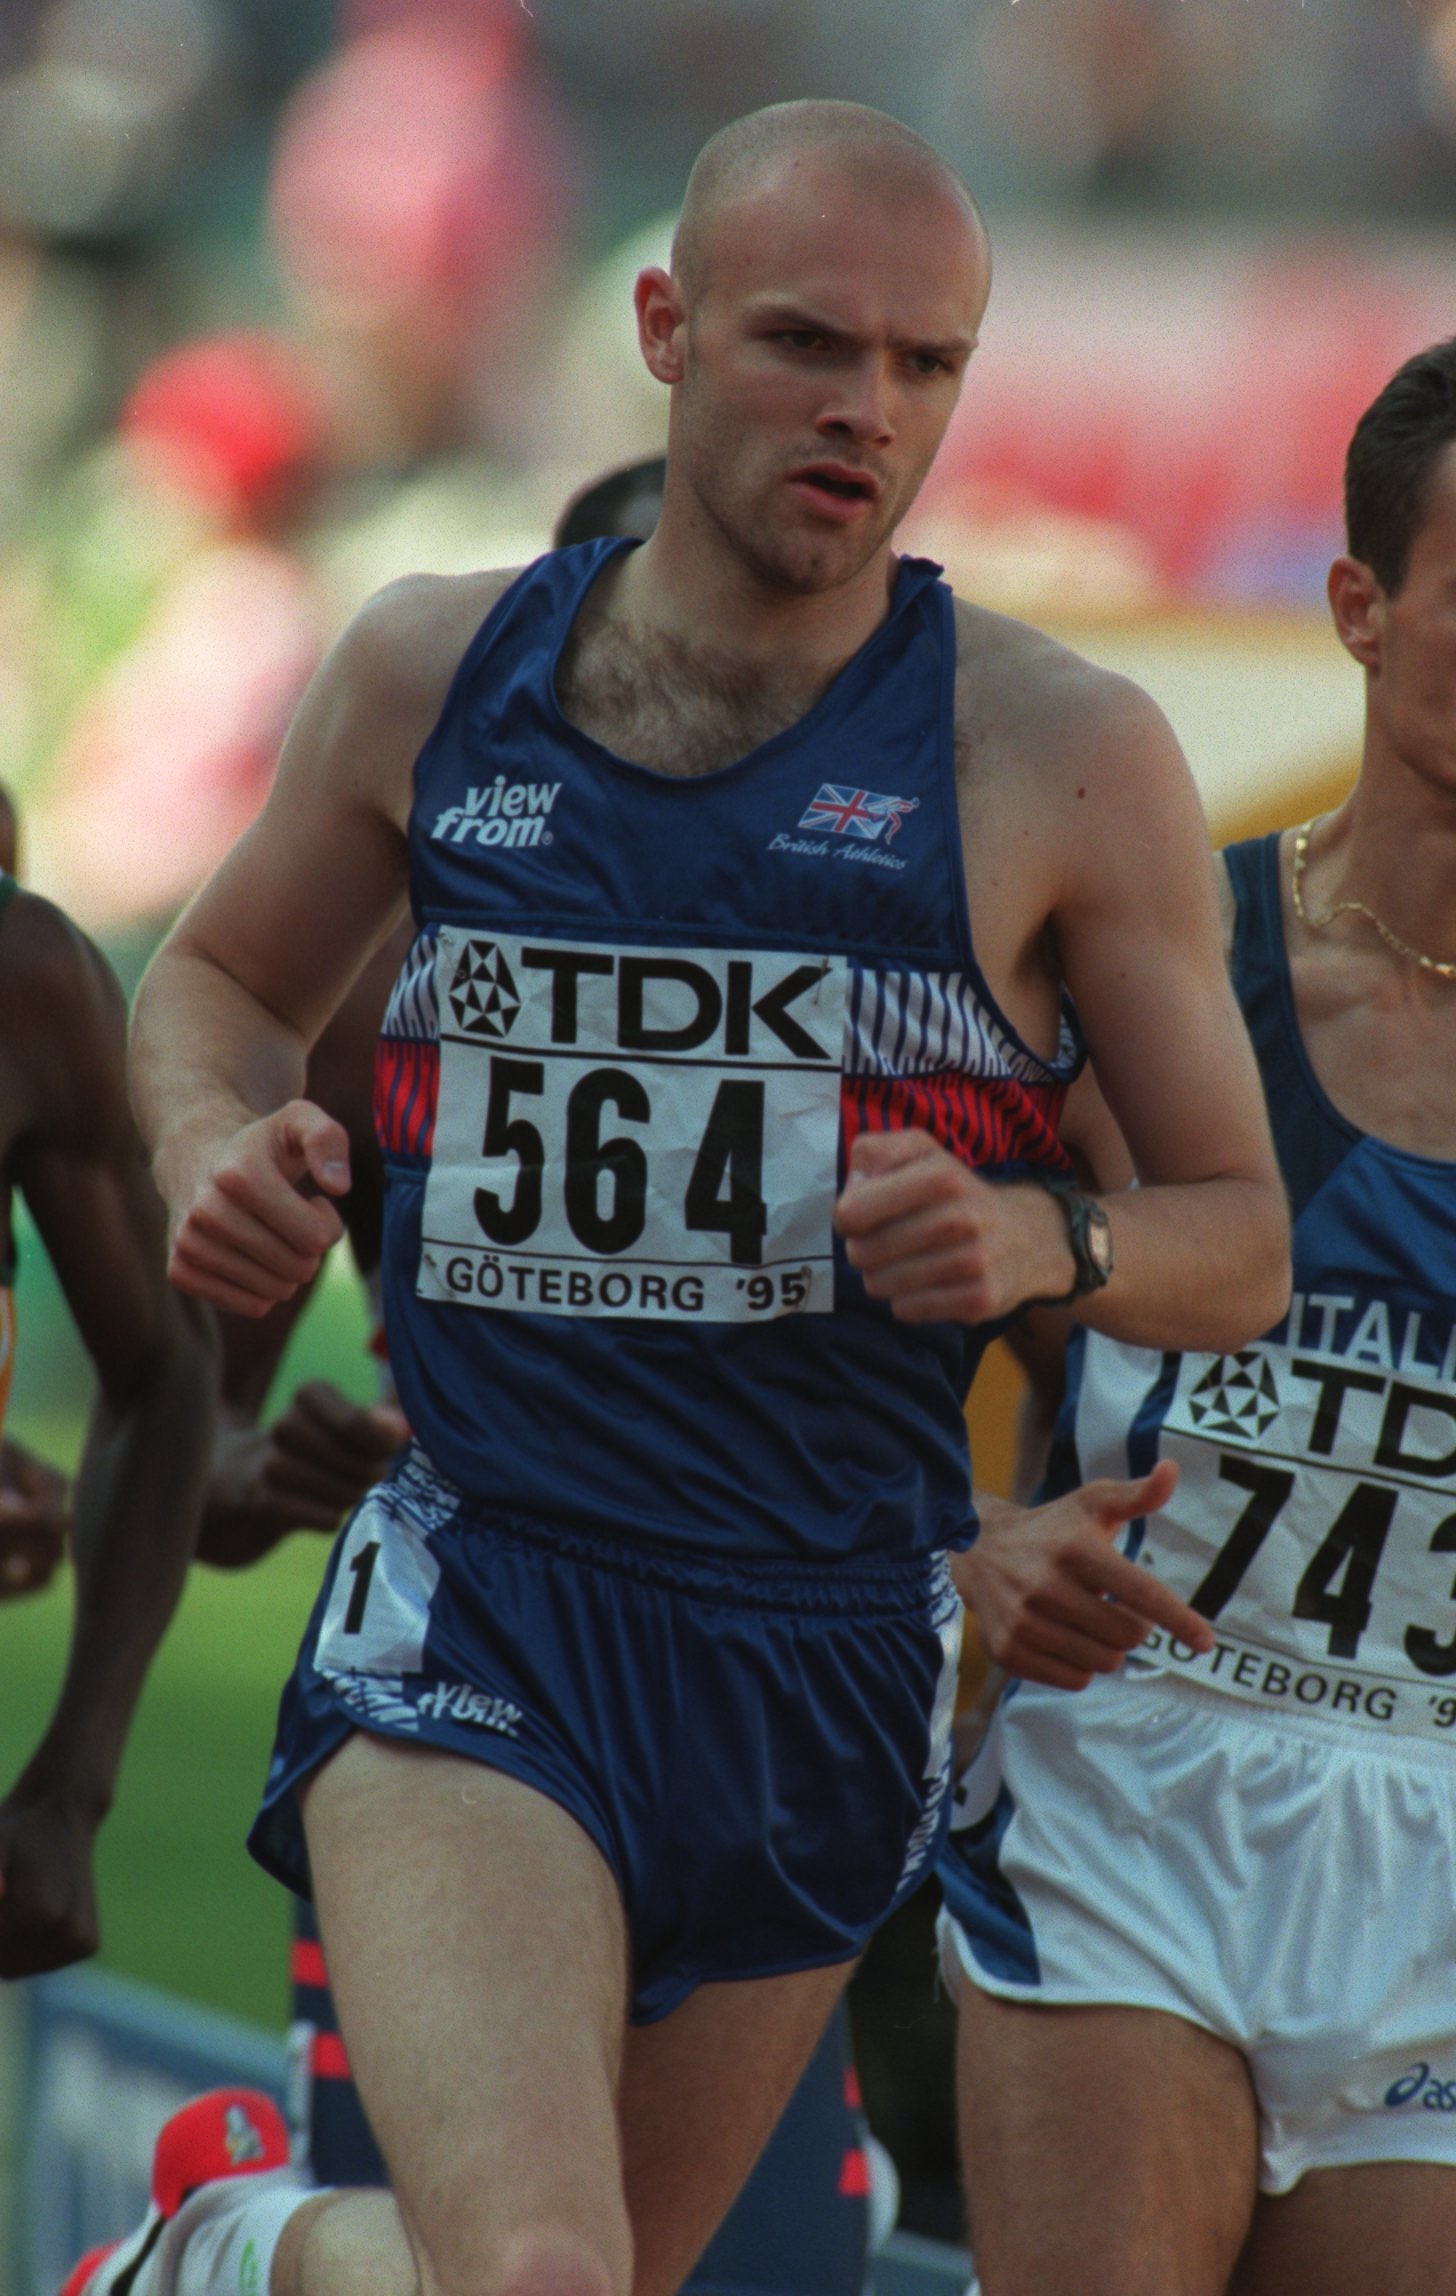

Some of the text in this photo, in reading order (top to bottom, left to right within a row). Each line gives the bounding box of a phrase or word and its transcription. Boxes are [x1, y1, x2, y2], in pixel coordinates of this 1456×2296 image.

[464, 774, 562, 817] view
[766, 832, 907, 870] British Athletics
[521, 947, 832, 1060] TDK
[473, 1055, 767, 1265] 564
[445, 1254, 806, 1311] GÖTEBORG '95
[343, 1540, 381, 1635] 1
